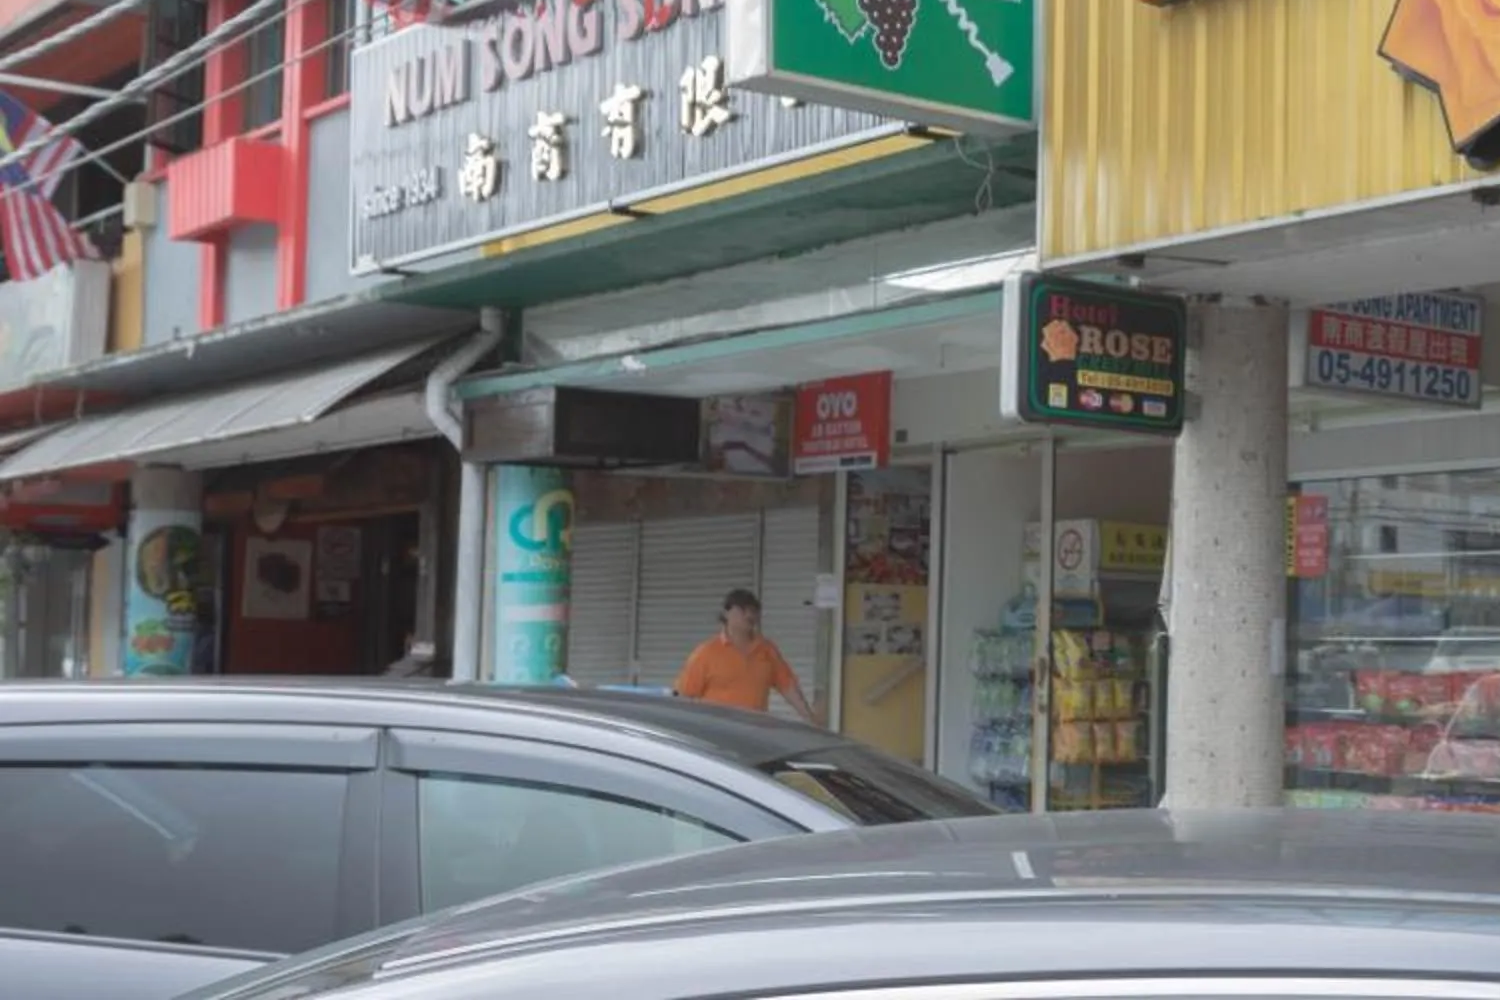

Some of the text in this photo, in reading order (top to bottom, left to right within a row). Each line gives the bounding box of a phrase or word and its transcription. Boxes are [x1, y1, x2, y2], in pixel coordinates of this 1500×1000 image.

[384, 37, 471, 128] NUM
[1394, 292, 1478, 333] APARTMENT
[1079, 326, 1172, 365] ROSE
[1318, 350, 1471, 400] 05-4911250
[816, 390, 858, 421] OYO
